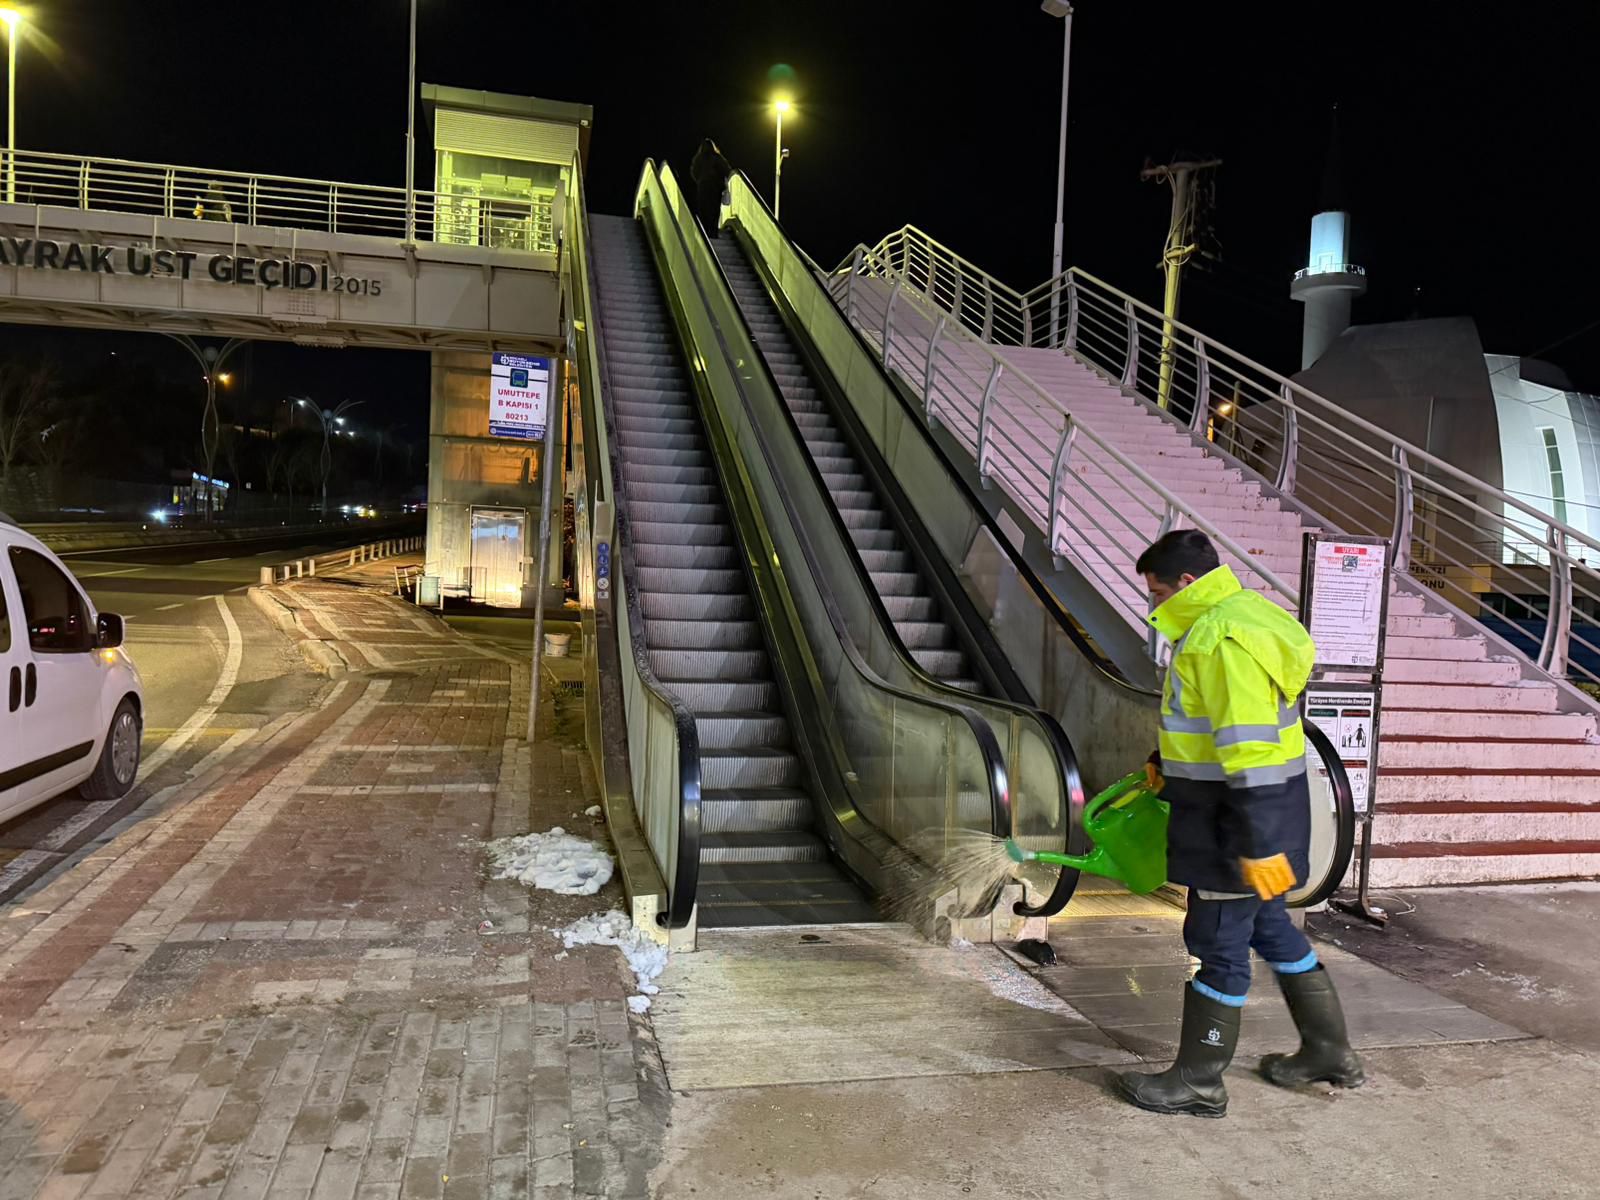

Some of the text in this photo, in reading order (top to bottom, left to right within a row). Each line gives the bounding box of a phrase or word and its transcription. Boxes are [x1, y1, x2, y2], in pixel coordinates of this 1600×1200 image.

[126, 241, 198, 280] ÜST
[207, 254, 329, 291] GEÇİDİ
[333, 276, 382, 296] 2015
[497, 388, 541, 400] UMUTTEPE
[505, 400, 532, 410] KAPISI
[505, 412, 529, 422] 80213
[1342, 547, 1360, 555] UYARI
